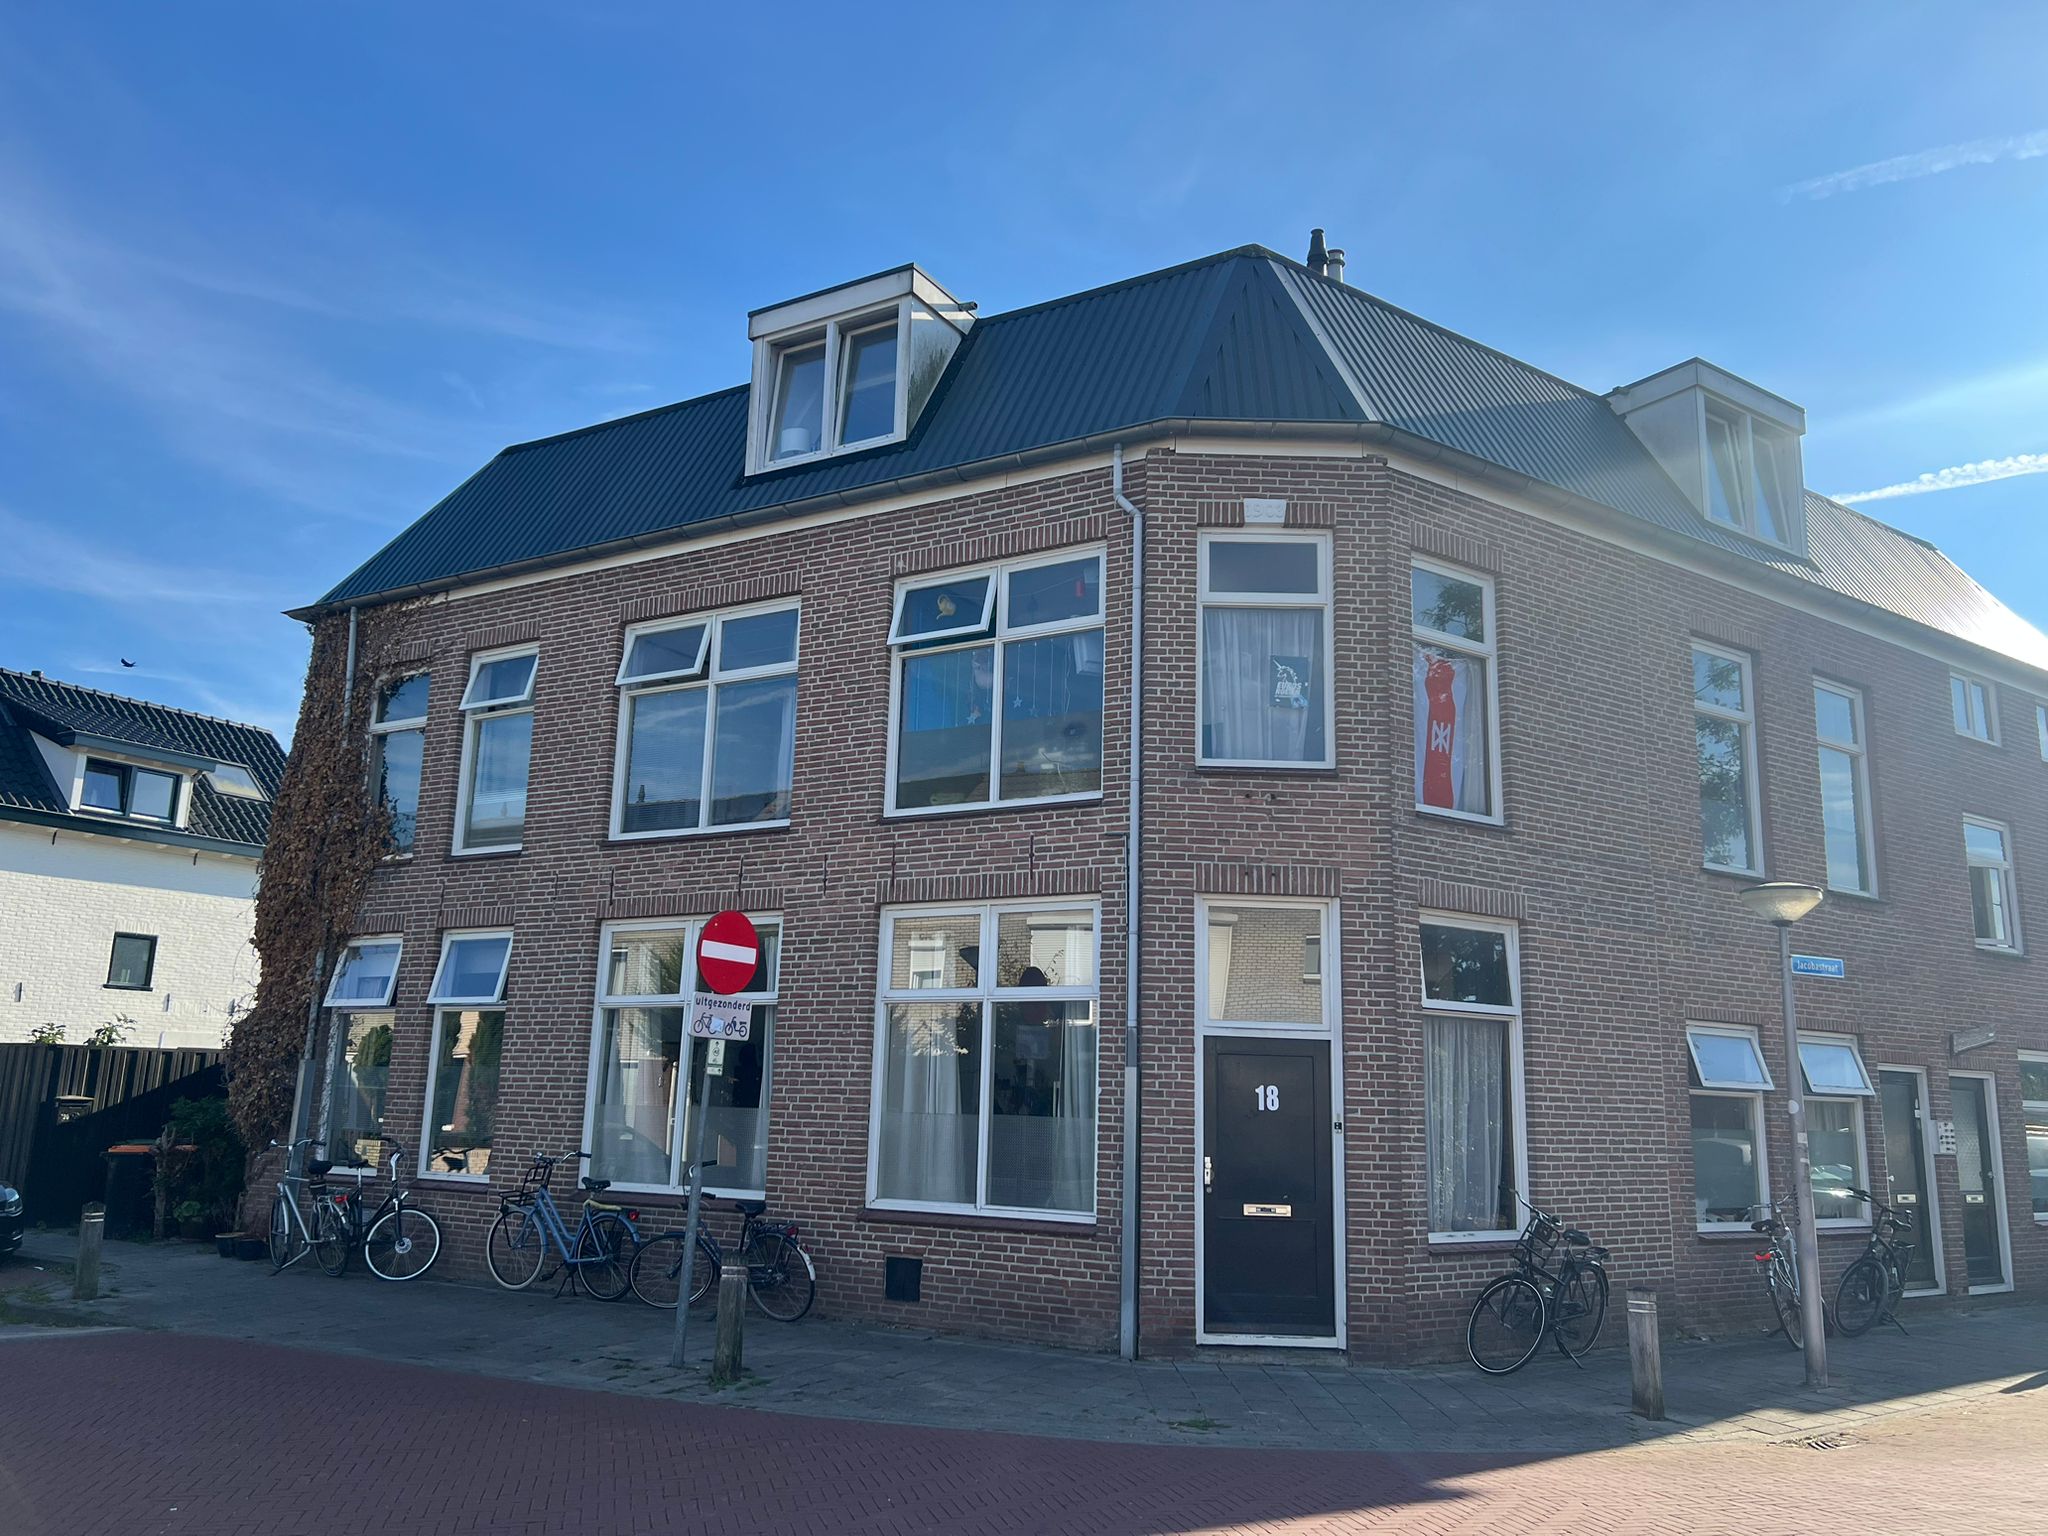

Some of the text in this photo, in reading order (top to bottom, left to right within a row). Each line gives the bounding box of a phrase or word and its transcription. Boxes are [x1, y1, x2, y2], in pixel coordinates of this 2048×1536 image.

[1797, 959, 1840, 972] Jacobastraat
[695, 997, 751, 1011] uitgezonderd
[1255, 1085, 1279, 1111] 18
